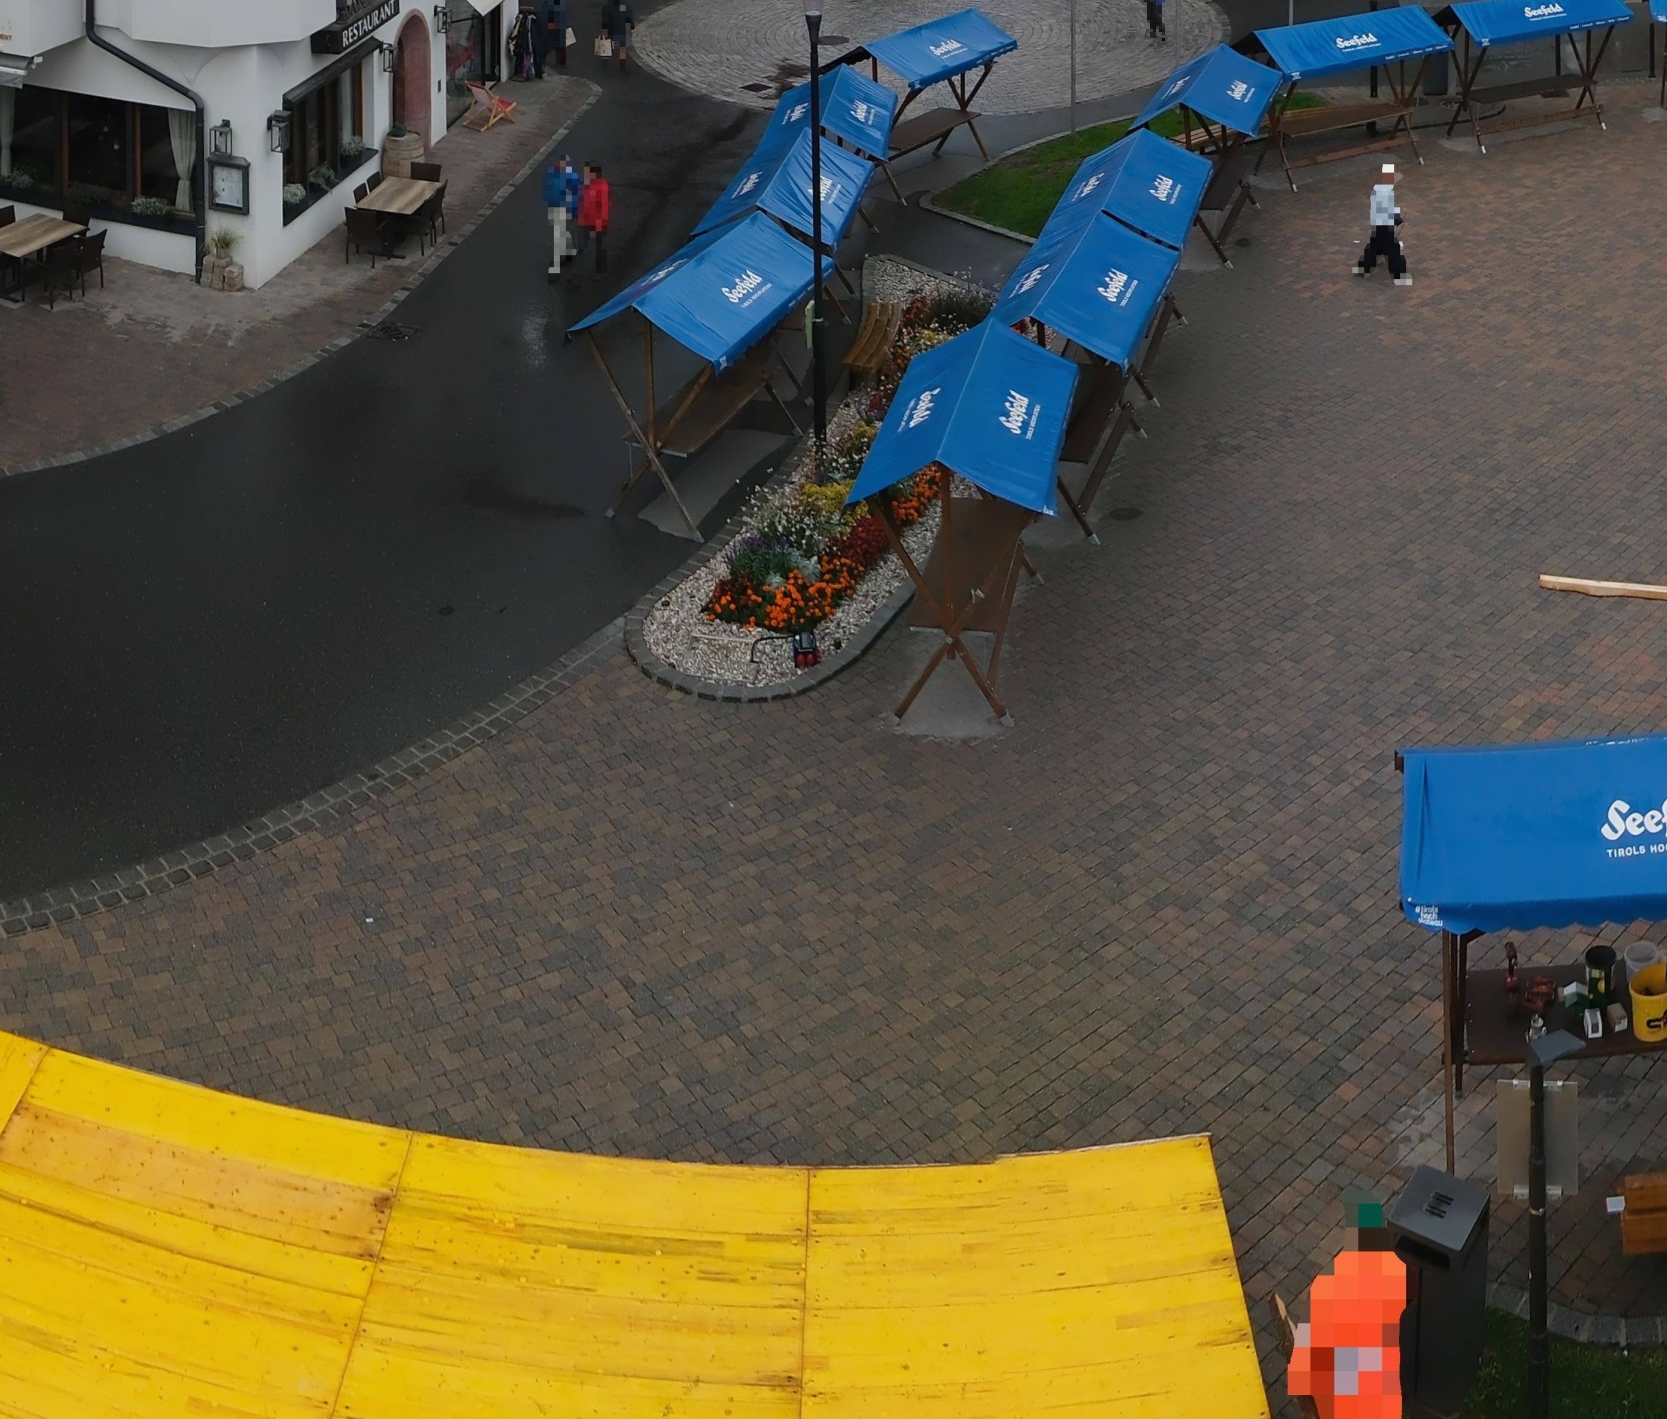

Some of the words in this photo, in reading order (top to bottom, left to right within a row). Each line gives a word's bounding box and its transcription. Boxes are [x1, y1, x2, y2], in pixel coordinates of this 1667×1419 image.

[342, 0, 396, 48] RESTAURANT
[1524, 3, 1564, 19] Seefeld
[1336, 33, 1378, 50] Seefeld
[721, 269, 764, 304] Seefeld
[1098, 268, 1128, 303] Seefeld
[999, 389, 1029, 435] Seefeld
[1606, 845, 1646, 858] TIROLS
